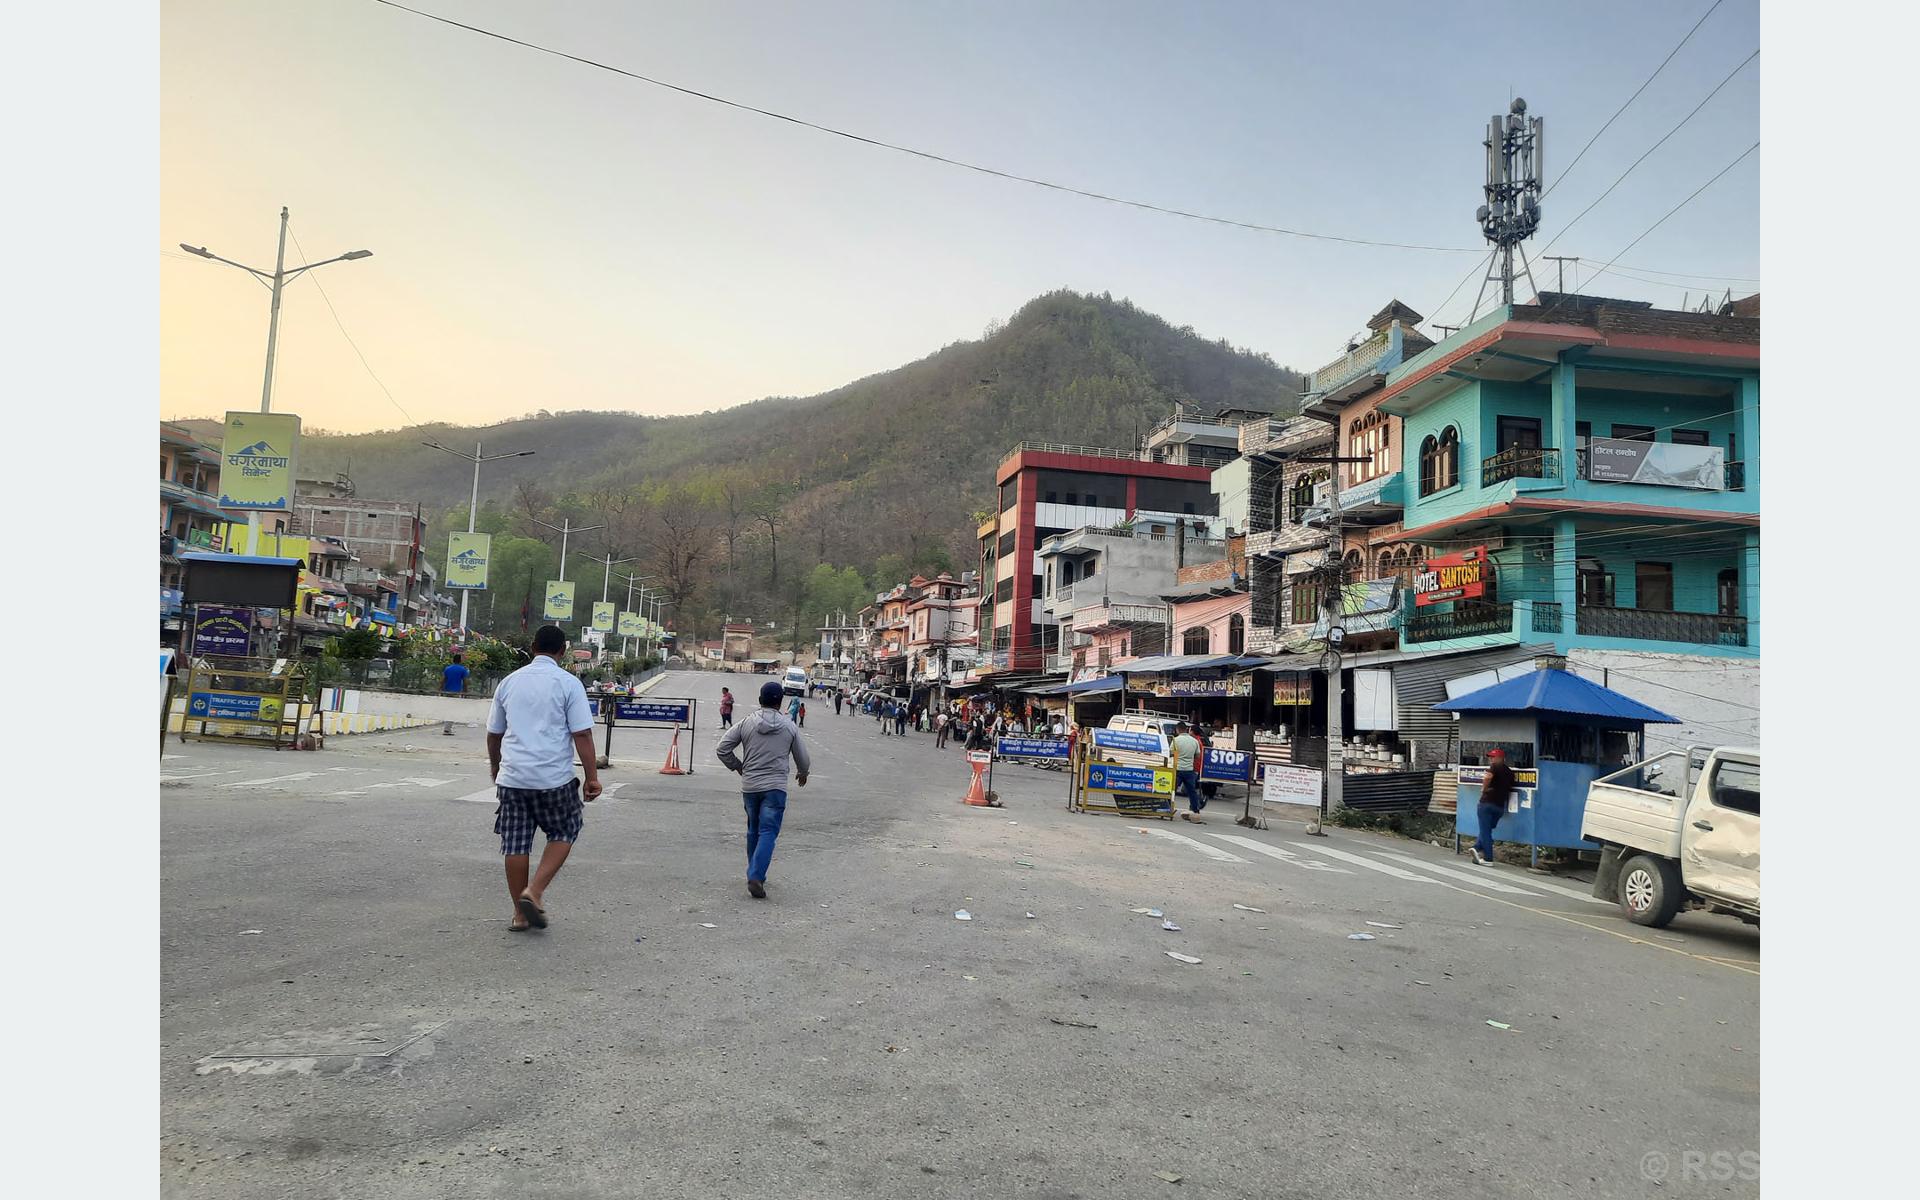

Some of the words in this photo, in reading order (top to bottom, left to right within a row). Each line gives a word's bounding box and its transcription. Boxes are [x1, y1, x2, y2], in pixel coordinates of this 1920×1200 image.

[1594, 446, 1613, 455] होटल
[227, 454, 289, 468] सगरमाथा
[1414, 570, 1439, 595] HOTEL
[1440, 560, 1481, 589] SANTOSH
[1190, 677, 1207, 693] होटल
[212, 697, 237, 705] TRAFFIC
[237, 699, 259, 707] POLICE
[1210, 749, 1245, 766] STOP
[1108, 769, 1132, 777] TRAFFIC
[1518, 772, 1536, 783] DRIVE
